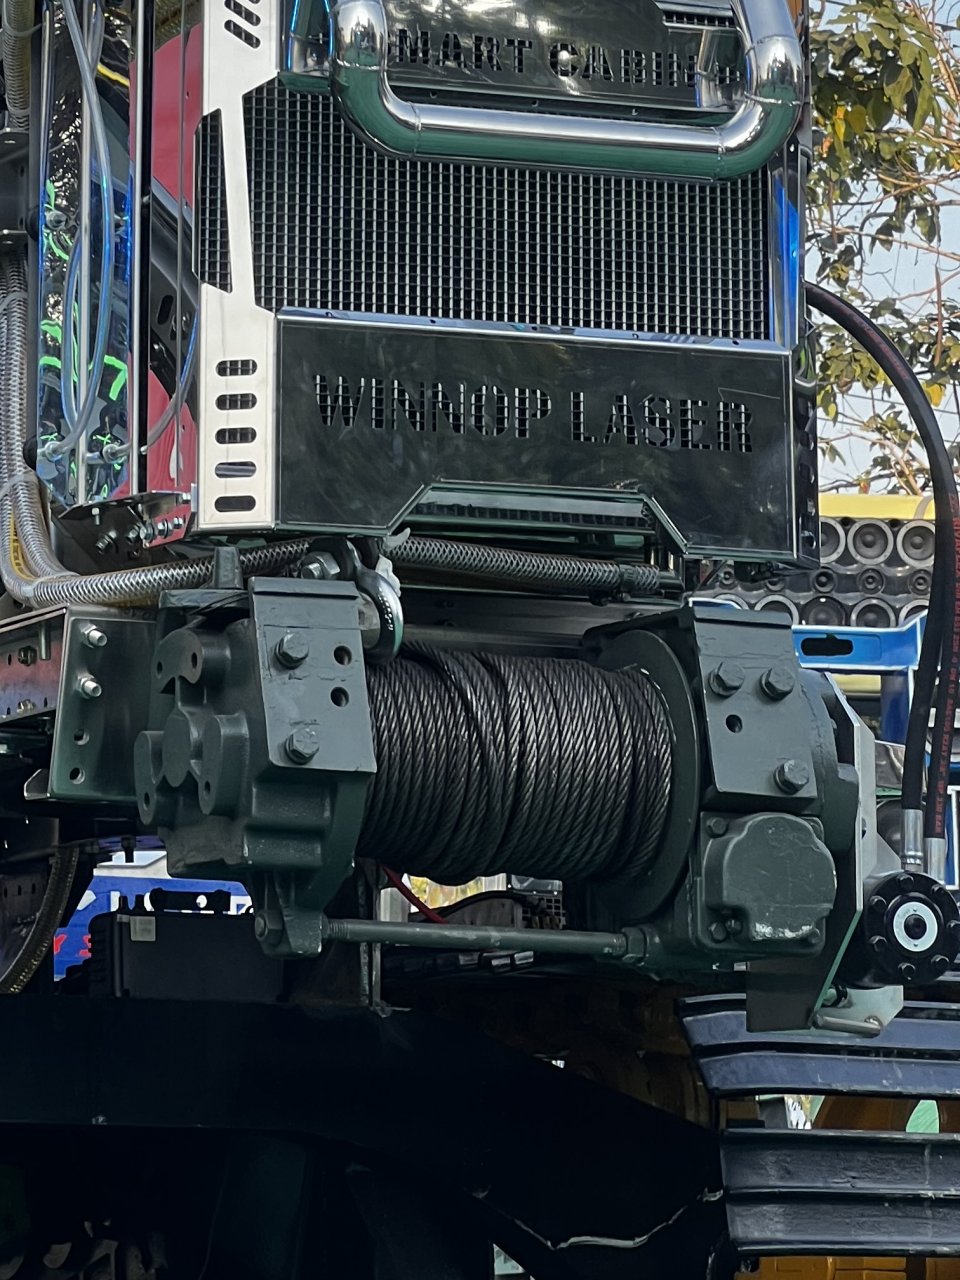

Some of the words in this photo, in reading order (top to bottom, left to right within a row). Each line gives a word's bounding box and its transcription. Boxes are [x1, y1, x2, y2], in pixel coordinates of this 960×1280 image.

[388, 28, 533, 74] MART
[547, 42, 698, 89] CABIN
[313, 374, 552, 439] WINNOP
[570, 391, 754, 453] LASER
